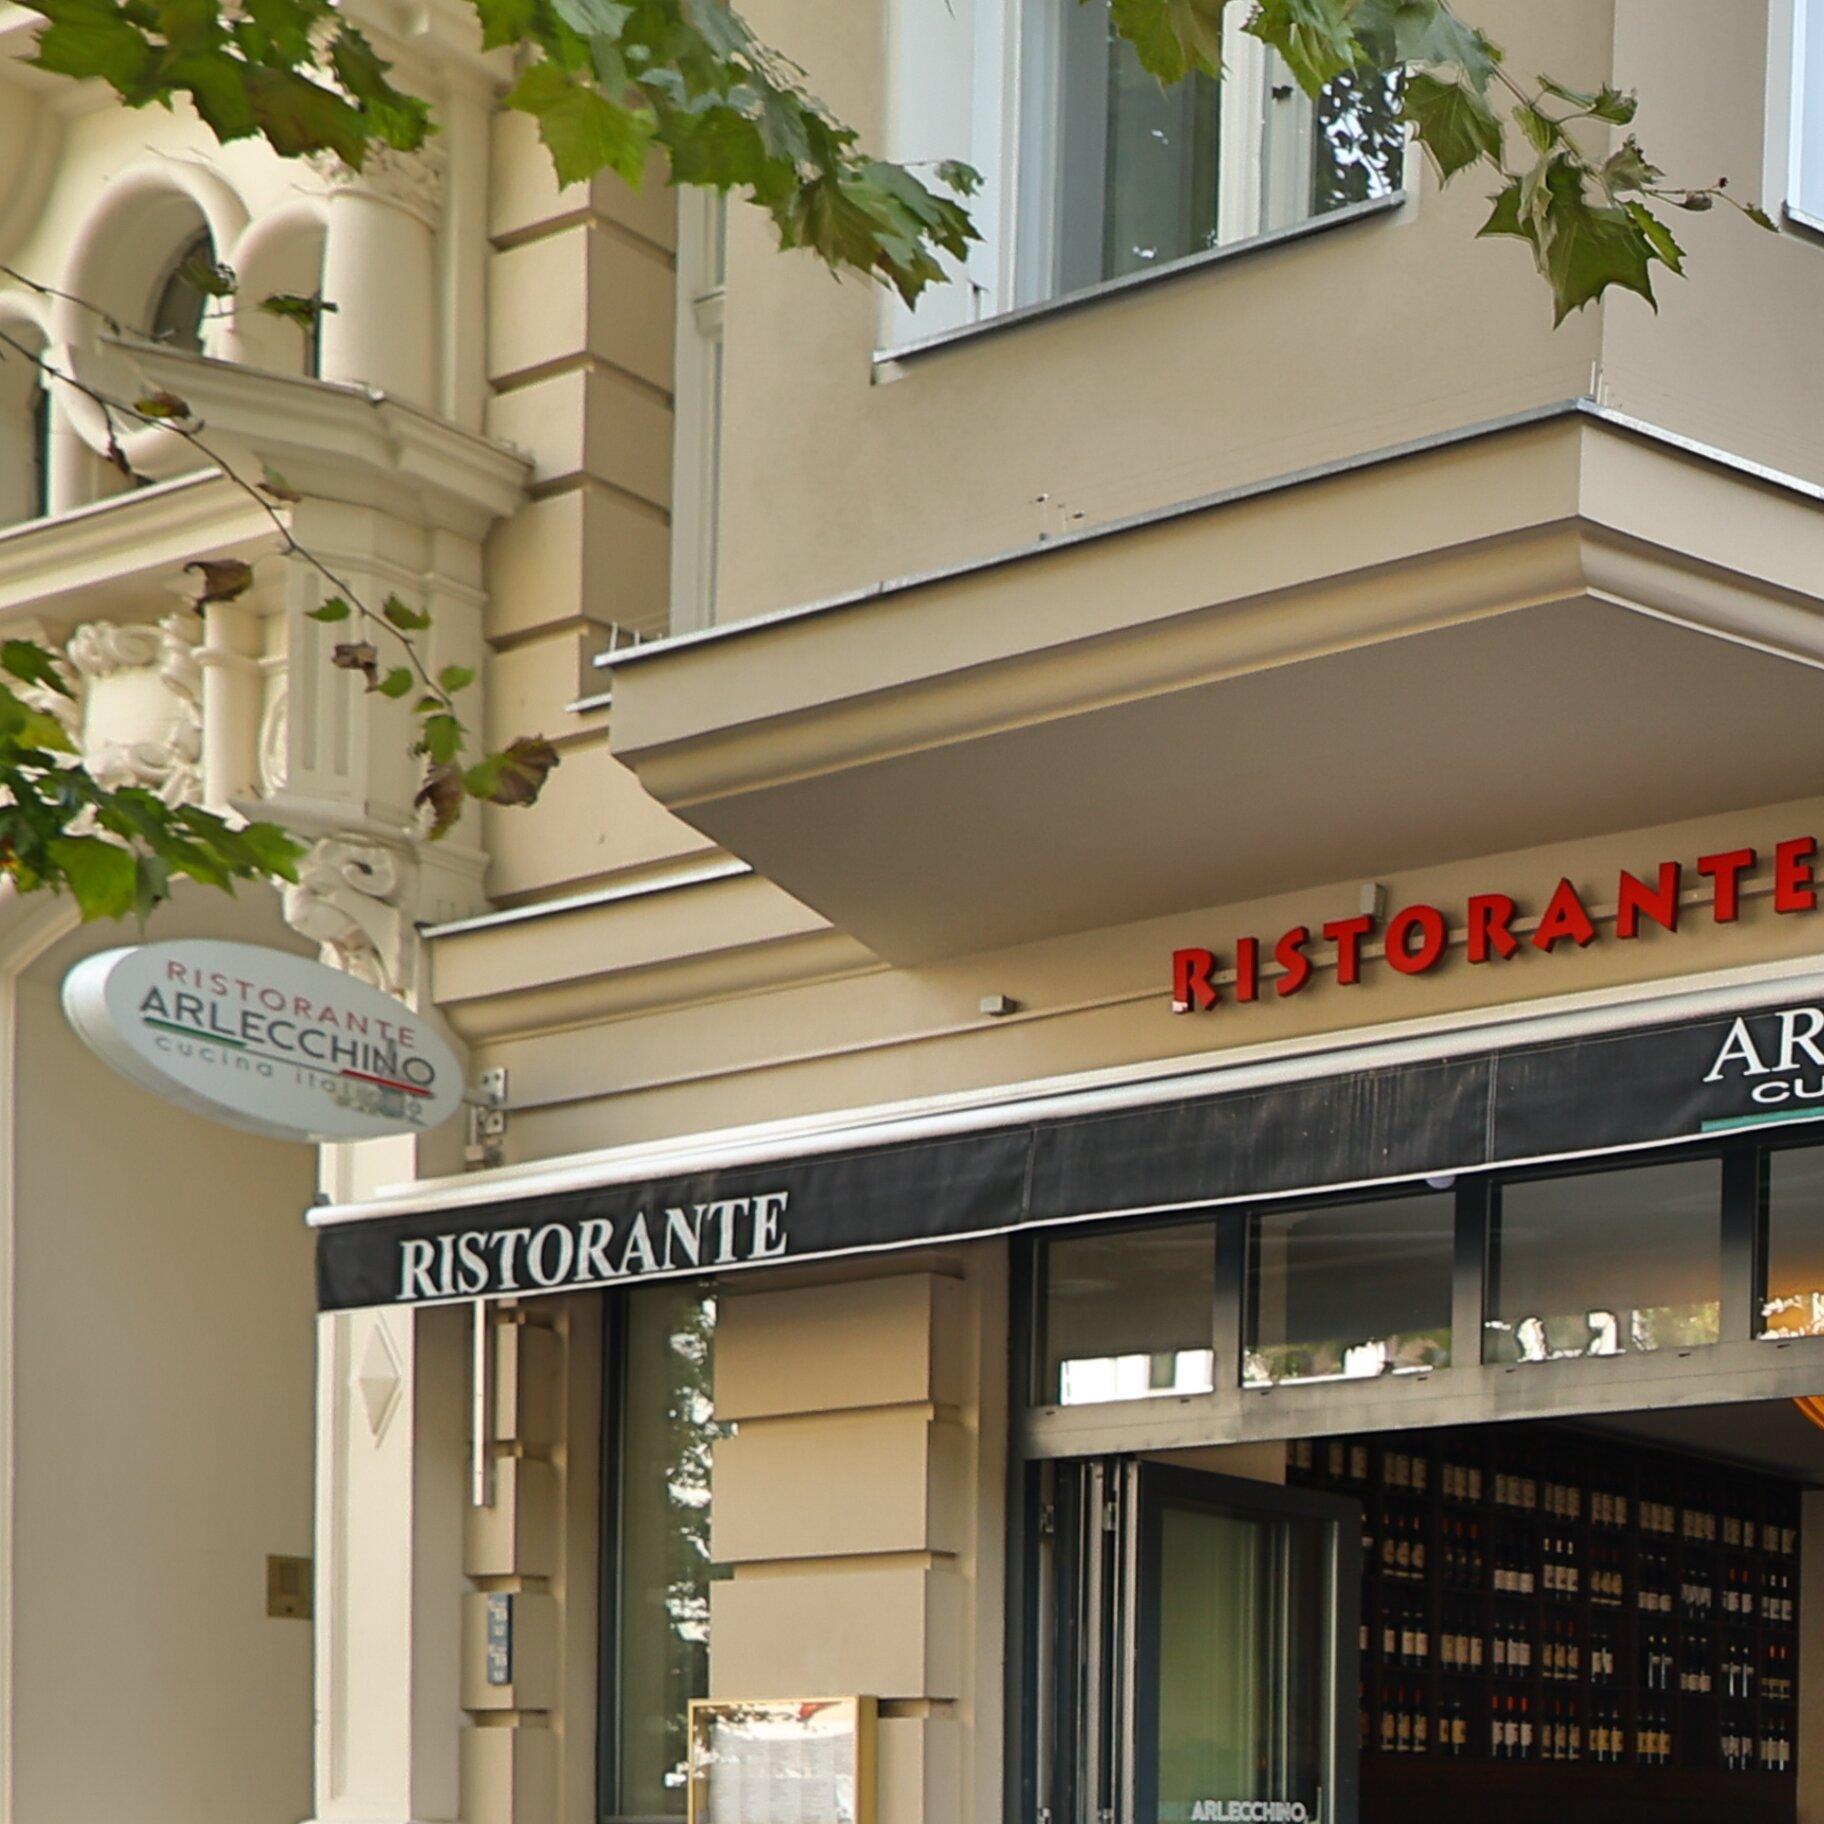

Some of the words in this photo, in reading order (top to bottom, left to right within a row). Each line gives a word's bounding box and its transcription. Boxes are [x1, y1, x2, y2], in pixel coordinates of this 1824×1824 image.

[1170, 835, 1818, 1015] RISTORANTE
[139, 985, 436, 1088] ARLECCHINO
[165, 959, 417, 1049] RISTORANTE
[154, 1035, 274, 1078] cucina
[396, 1190, 790, 1300] RISTORANTE
[1191, 1799, 1307, 1823] ARLECCHINO
